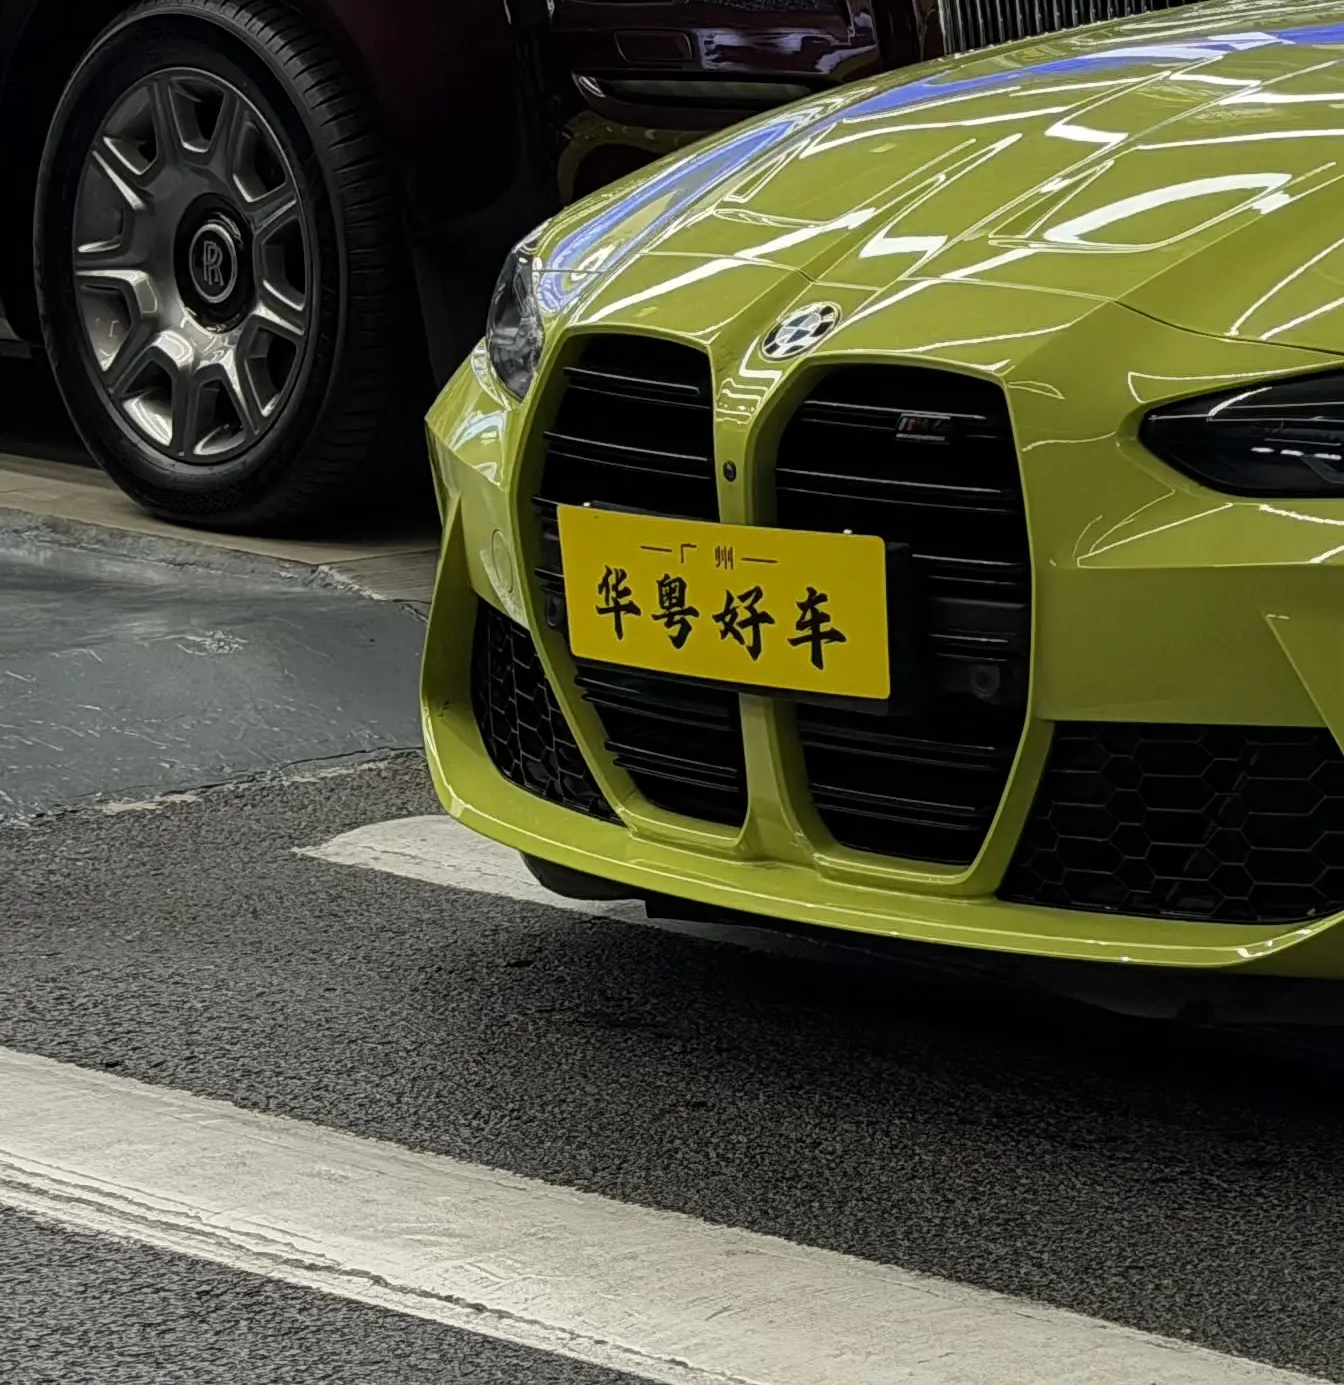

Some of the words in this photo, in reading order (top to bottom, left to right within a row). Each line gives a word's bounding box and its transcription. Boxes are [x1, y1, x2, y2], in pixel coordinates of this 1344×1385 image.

[680, 543, 734, 570] 广州
[595, 564, 847, 671] 华粤好车
